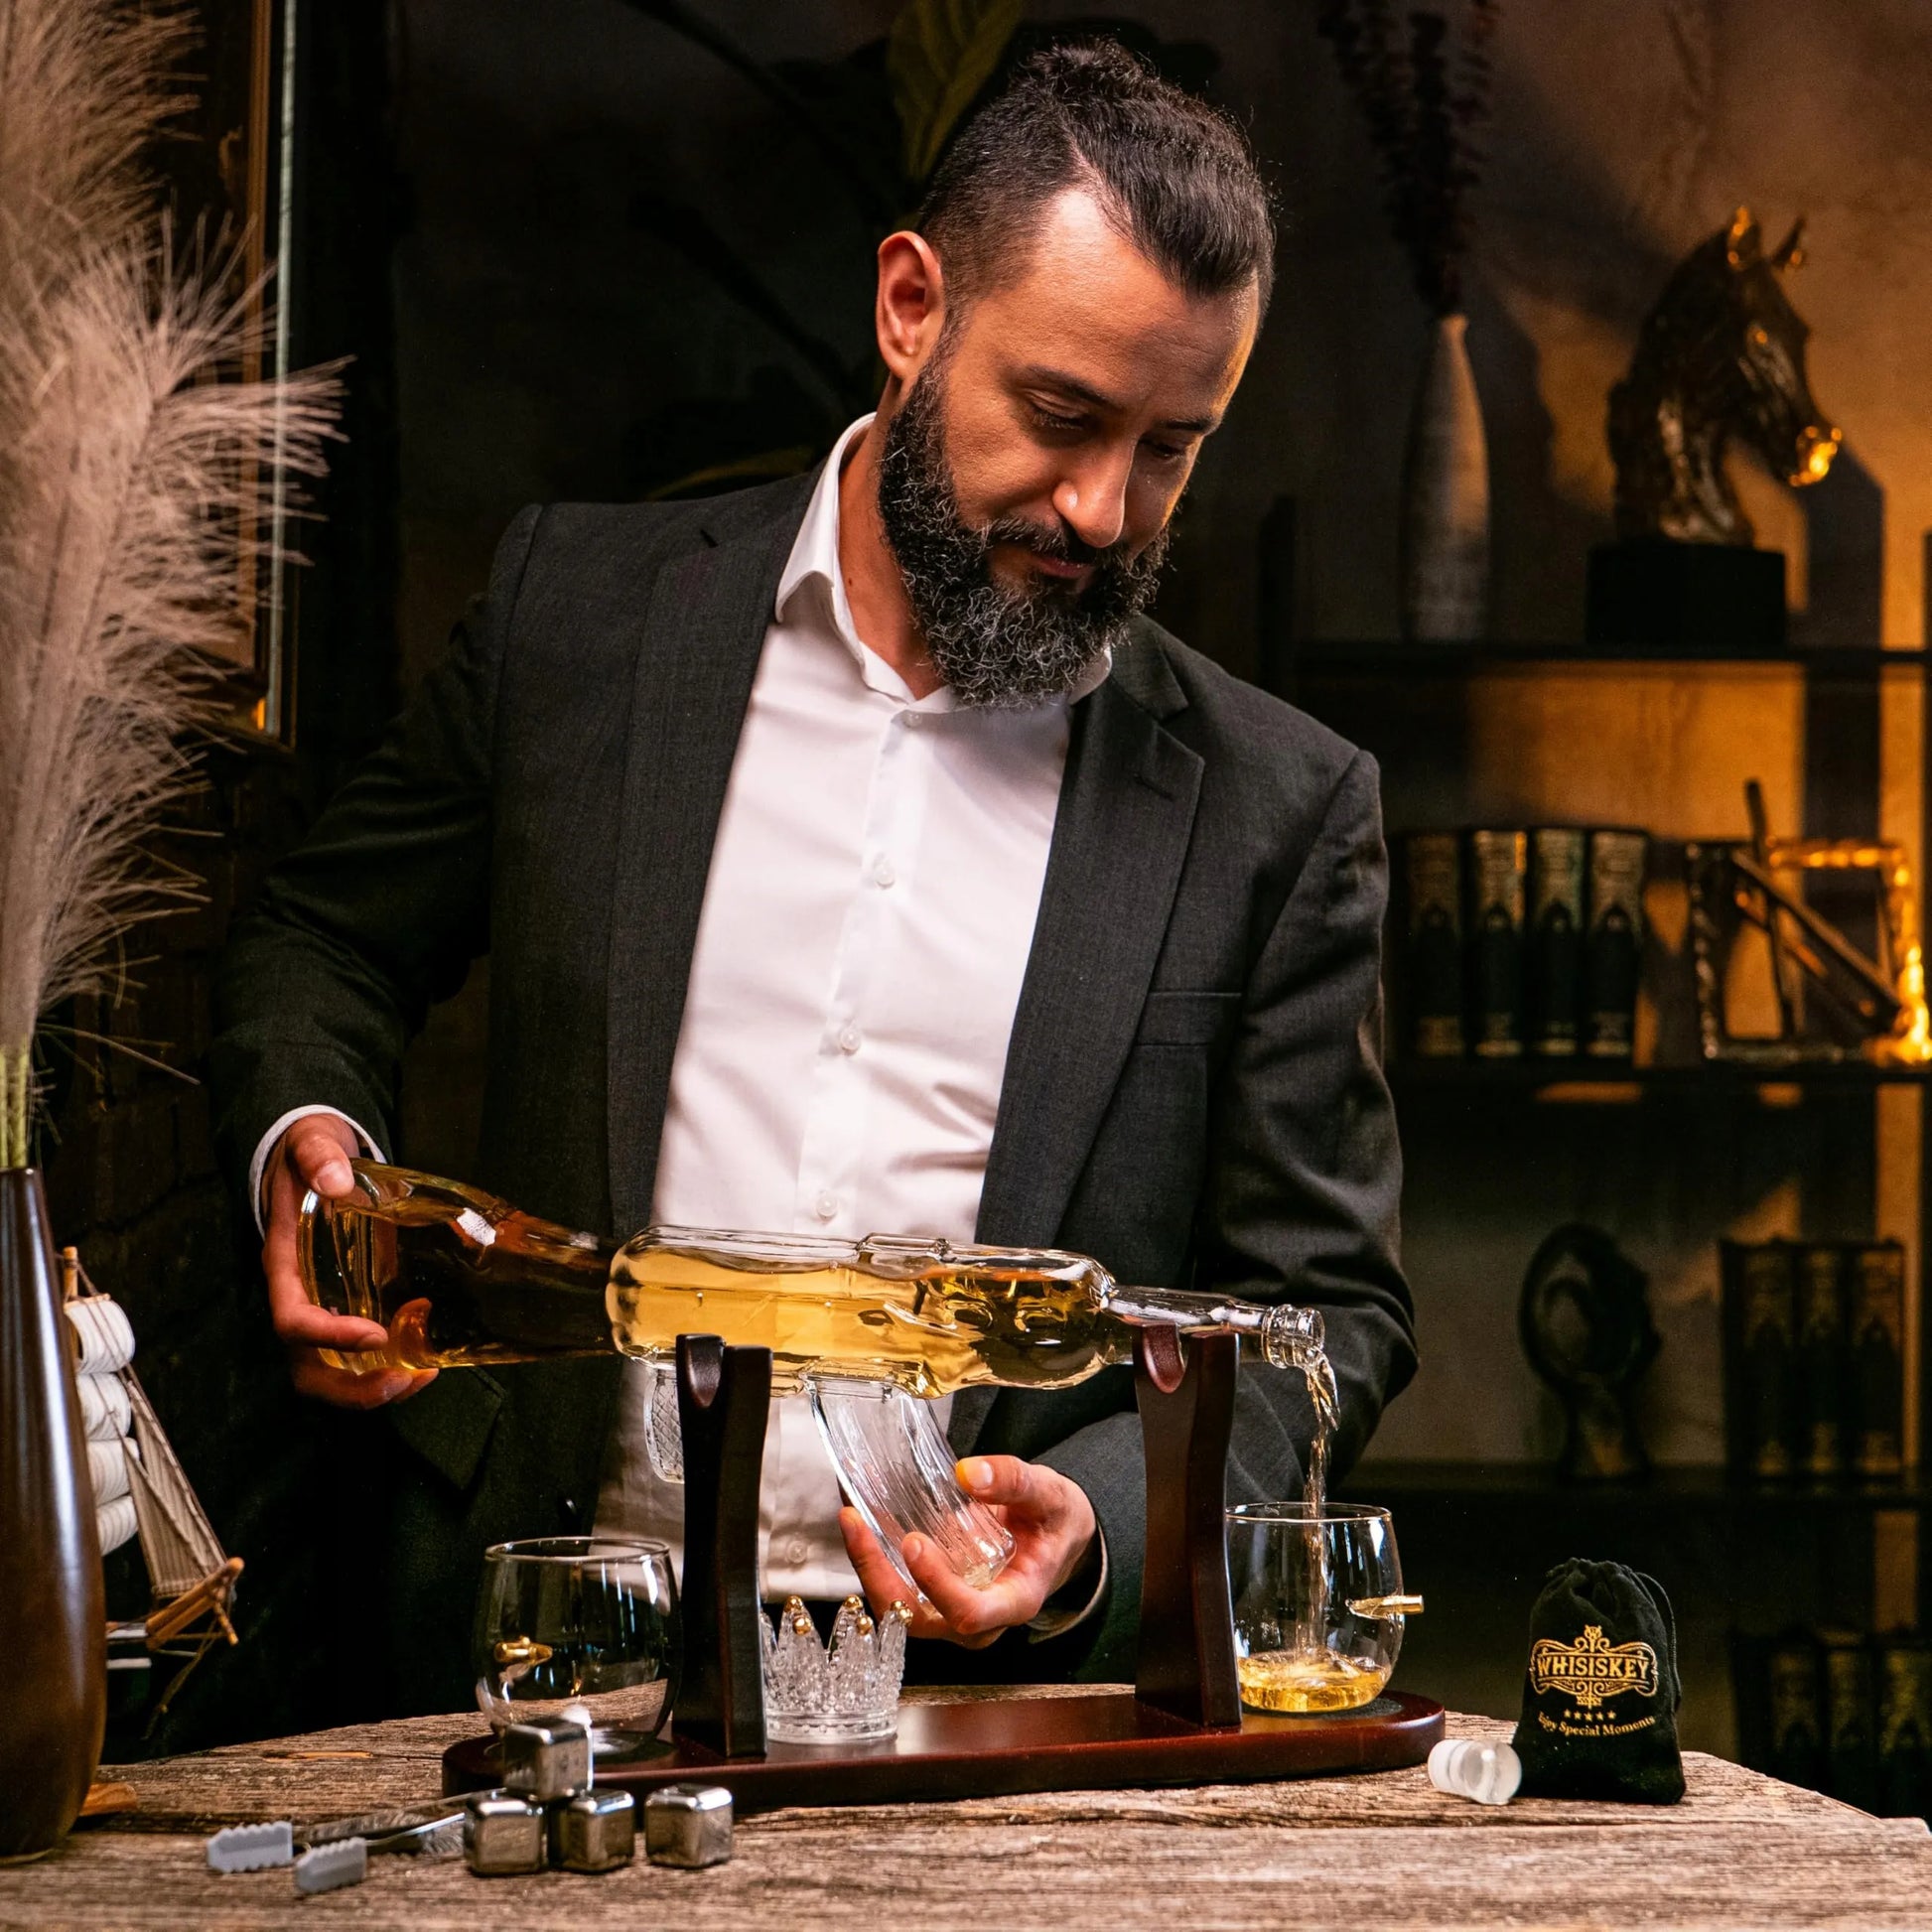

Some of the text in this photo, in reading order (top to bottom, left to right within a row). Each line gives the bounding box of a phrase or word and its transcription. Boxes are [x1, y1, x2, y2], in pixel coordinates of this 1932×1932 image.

[1537, 1655, 1650, 1680] WHISISKEY
[1559, 1722, 1600, 1736] Special
[1602, 1715, 1656, 1736] Moments
